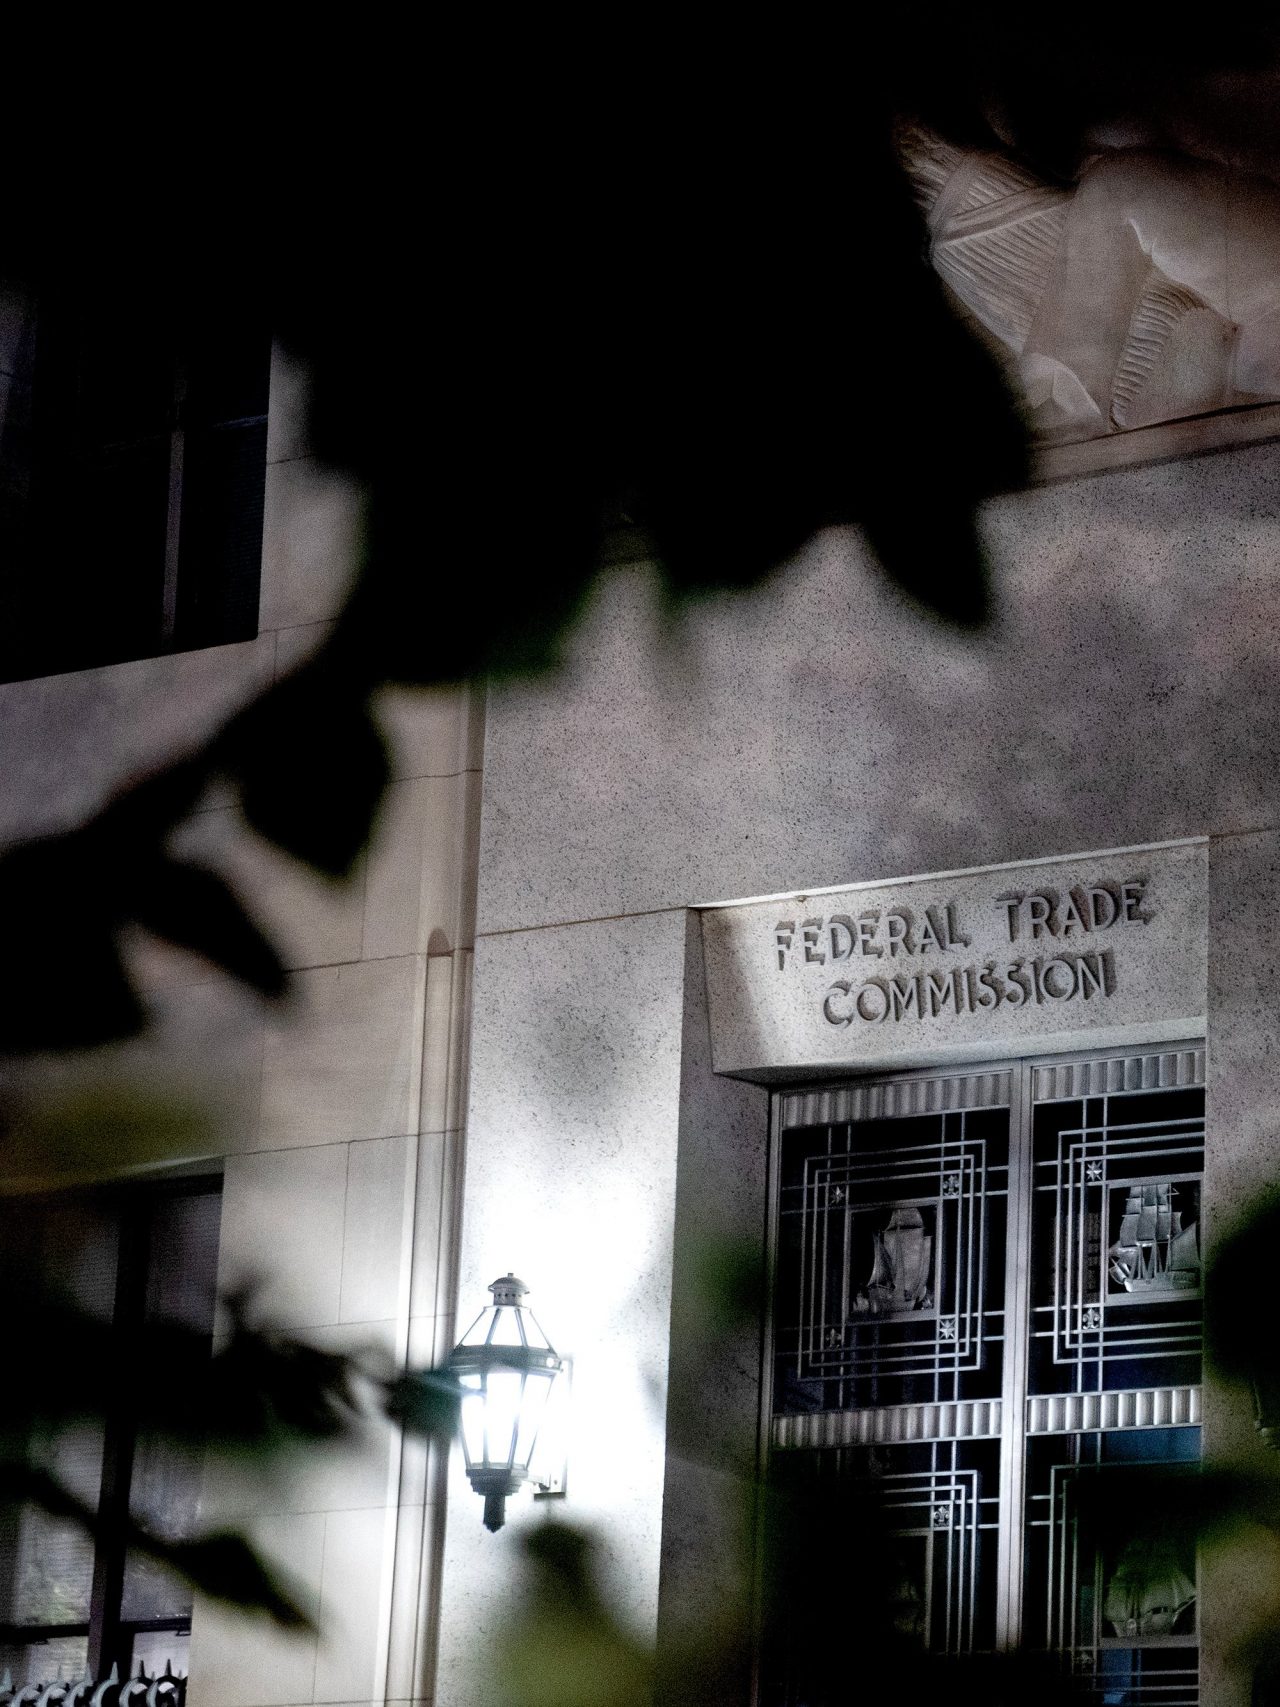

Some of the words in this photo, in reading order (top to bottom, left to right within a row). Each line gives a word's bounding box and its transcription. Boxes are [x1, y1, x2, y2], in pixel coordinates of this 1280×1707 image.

[773, 900, 972, 971] FEDERAL
[999, 875, 1155, 943] TRADE
[822, 948, 1118, 1029] COMMISSION
